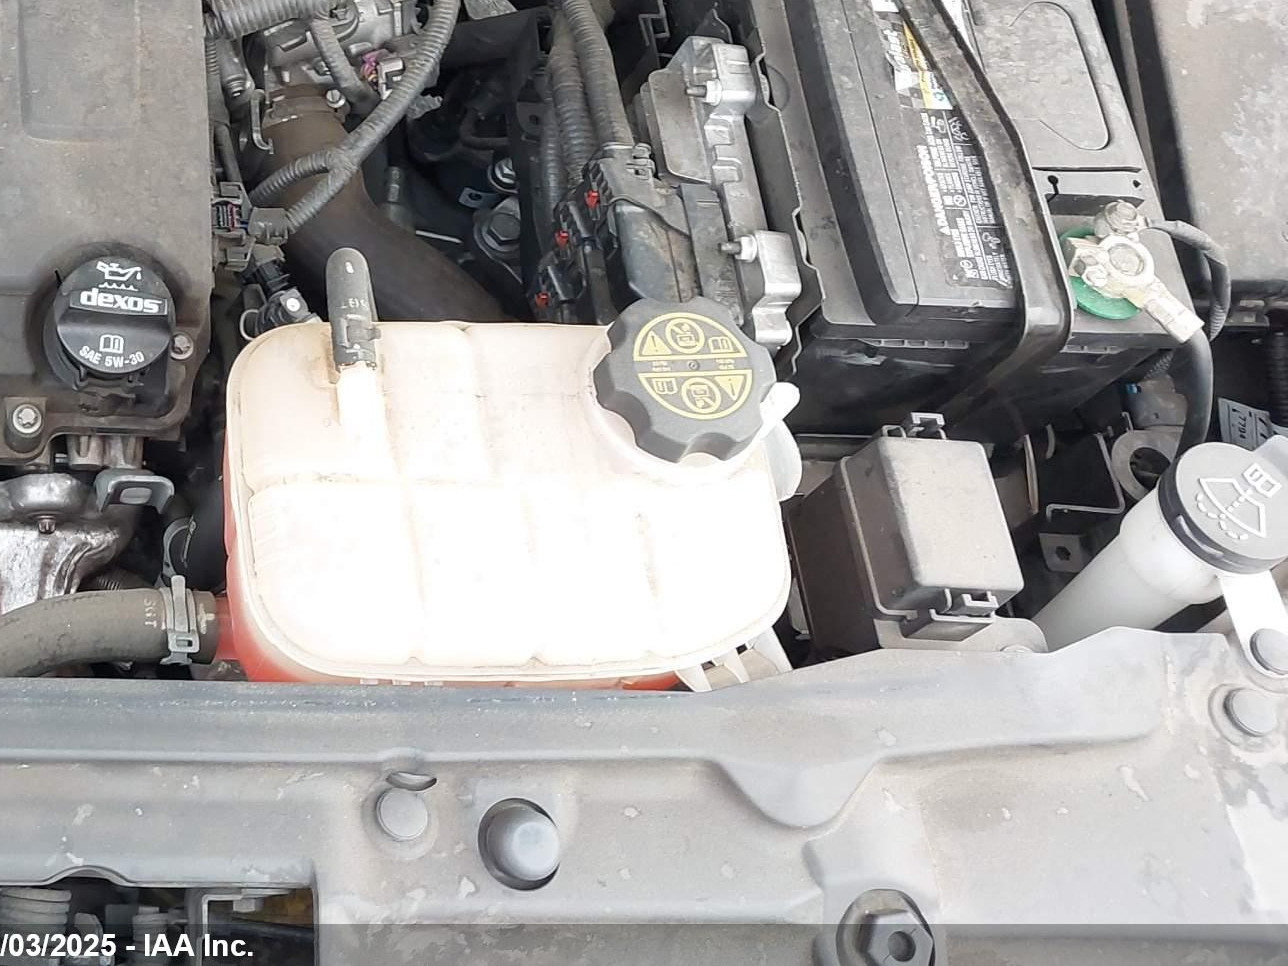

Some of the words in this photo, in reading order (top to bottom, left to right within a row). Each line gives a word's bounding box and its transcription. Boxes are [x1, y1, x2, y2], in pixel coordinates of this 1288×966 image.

[80, 287, 163, 314] dexos
[79, 345, 102, 365] SAE
[104, 351, 145, 368] 5W-30
